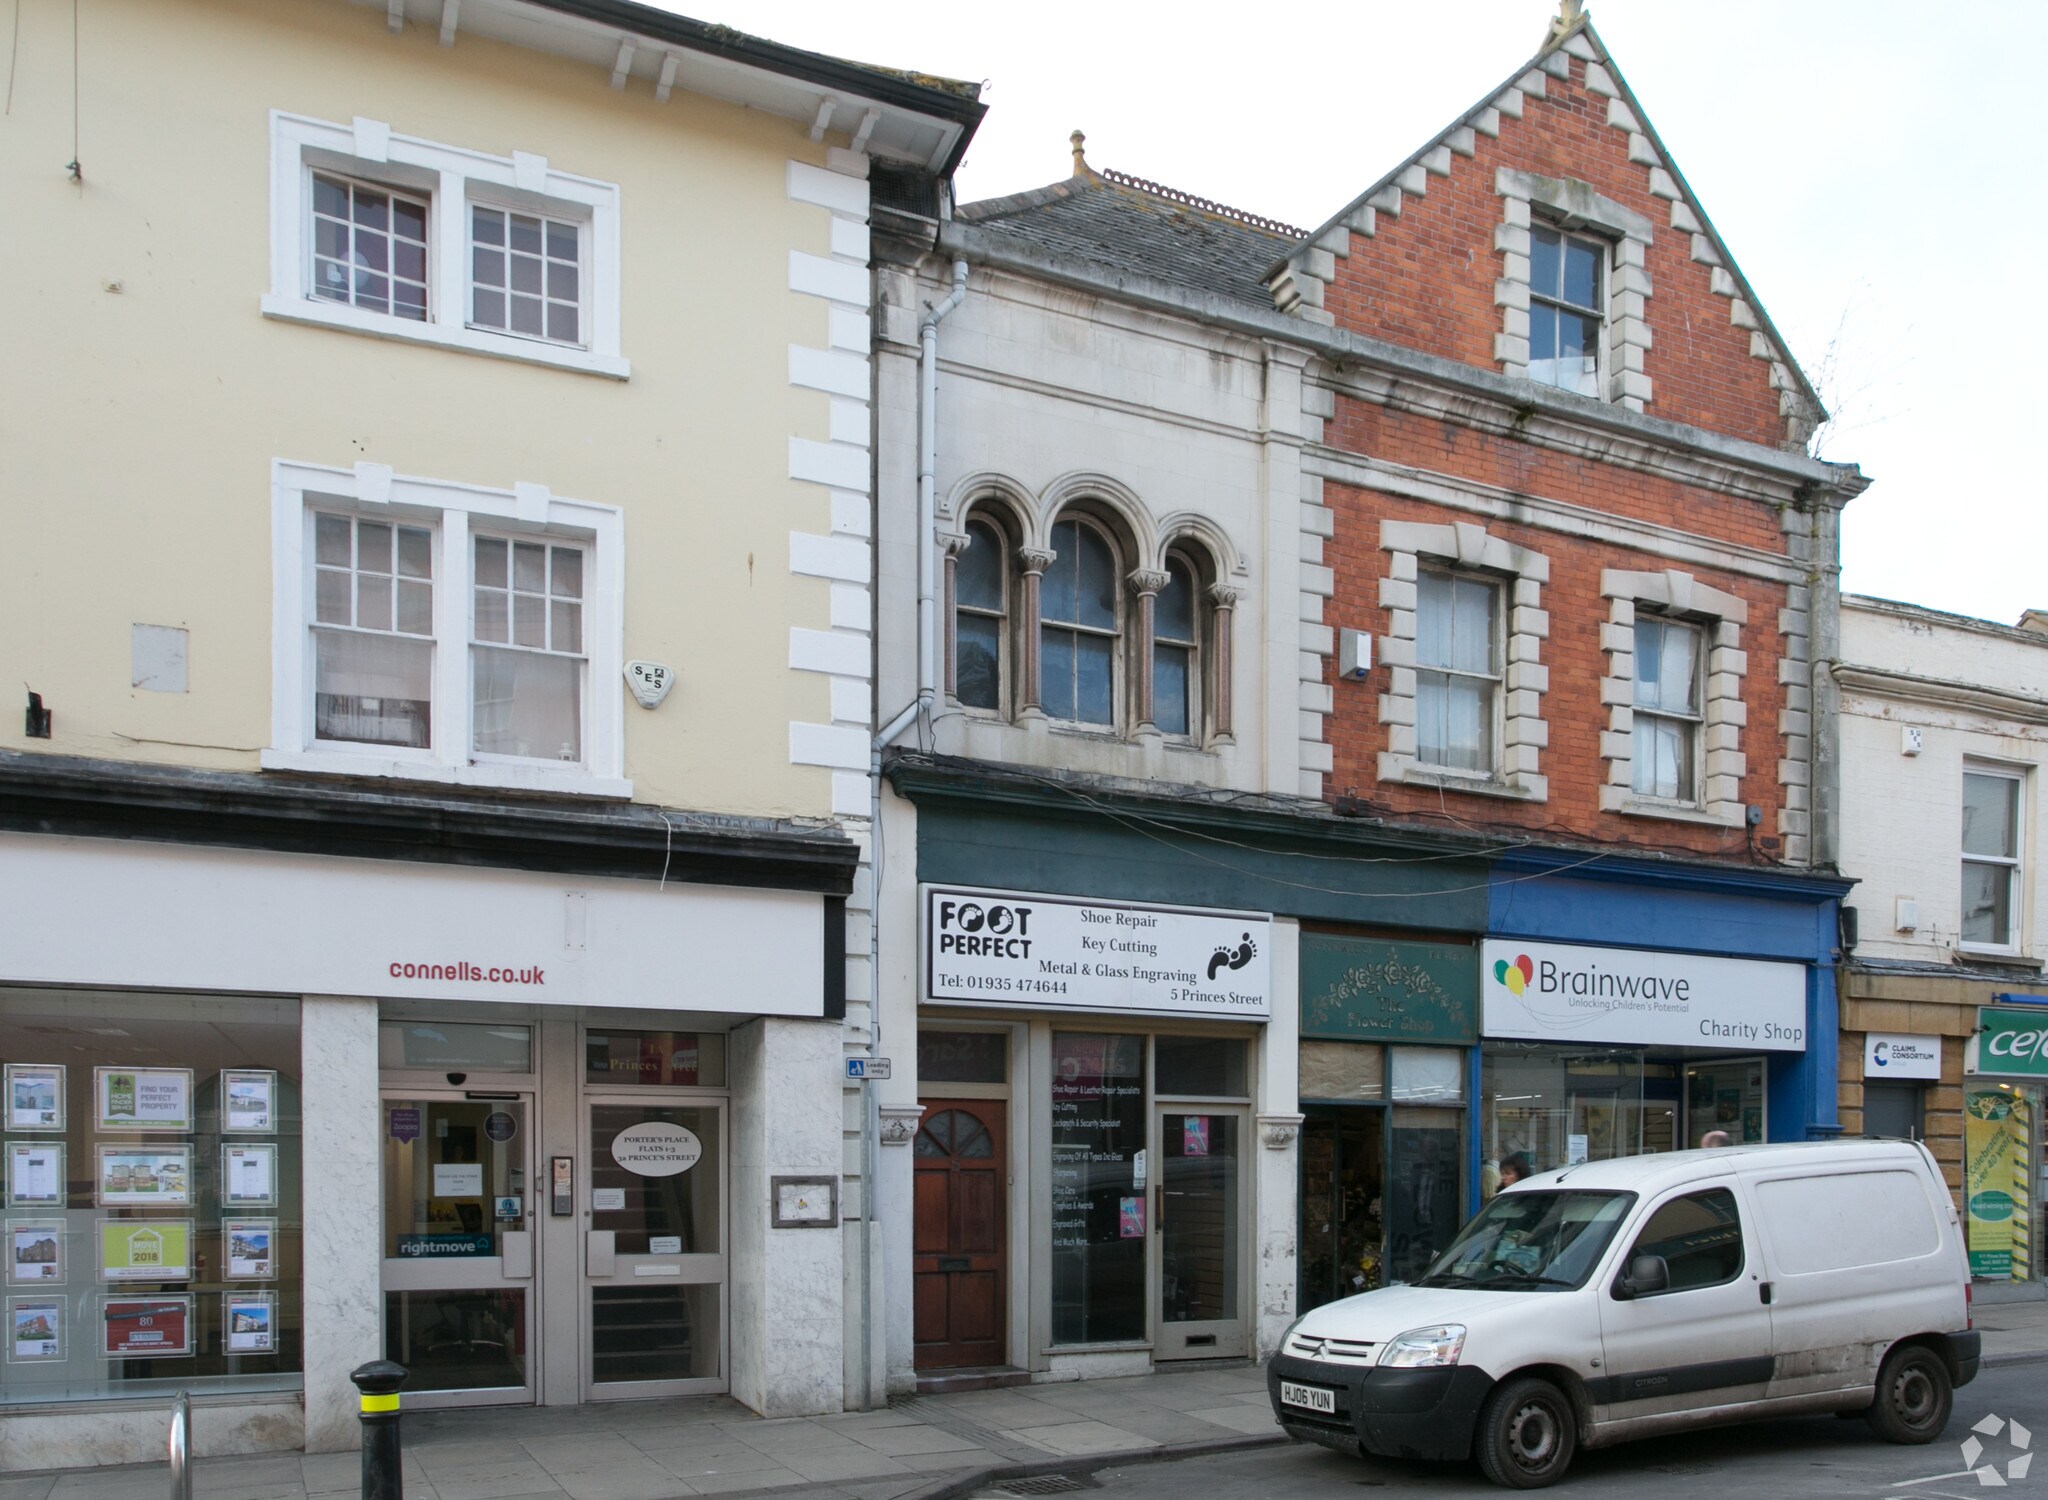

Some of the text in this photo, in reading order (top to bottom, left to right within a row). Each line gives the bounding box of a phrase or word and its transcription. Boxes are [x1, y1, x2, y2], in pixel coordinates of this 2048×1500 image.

[635, 666, 662, 688] SES
[941, 901, 1032, 936] FOOT
[1081, 909, 1158, 929] Shoe Repair
[940, 934, 1032, 959] PERFECT
[1082, 936, 1157, 957] Key Cutting
[389, 961, 545, 985] connells.co.uk
[1039, 960, 1197, 986] Metal & Glass Engraving
[1540, 960, 1689, 1001] Brainwave
[938, 973, 1067, 993] Tel: 01935 474644
[1170, 989, 1263, 1006] 5 Princes Street
[1377, 997, 1405, 1012] The
[1569, 998, 1689, 1013] Unlocking Children's Potential
[1348, 1012, 1434, 1033] Flower Shop
[1700, 1019, 1803, 1043] Charity Shop
[1891, 1052, 1934, 1060] CONSORTIUM
[141, 1085, 157, 1093] FIND
[1052, 1085, 1063, 1094] Shoe
[1061, 1103, 1078, 1113] Cutting
[393, 1123, 418, 1131] Zoopla
[1080, 1119, 1099, 1129] Security
[1969, 1126, 2006, 1174] Celebrating
[1077, 1202, 1094, 1210] Awards
[134, 1241, 157, 1249] MOVE
[401, 1242, 475, 1256] rightmove
[134, 1252, 158, 1262] 2018
[139, 1316, 153, 1326] 80
[1284, 1385, 1331, 1410] HJ06 YUN
